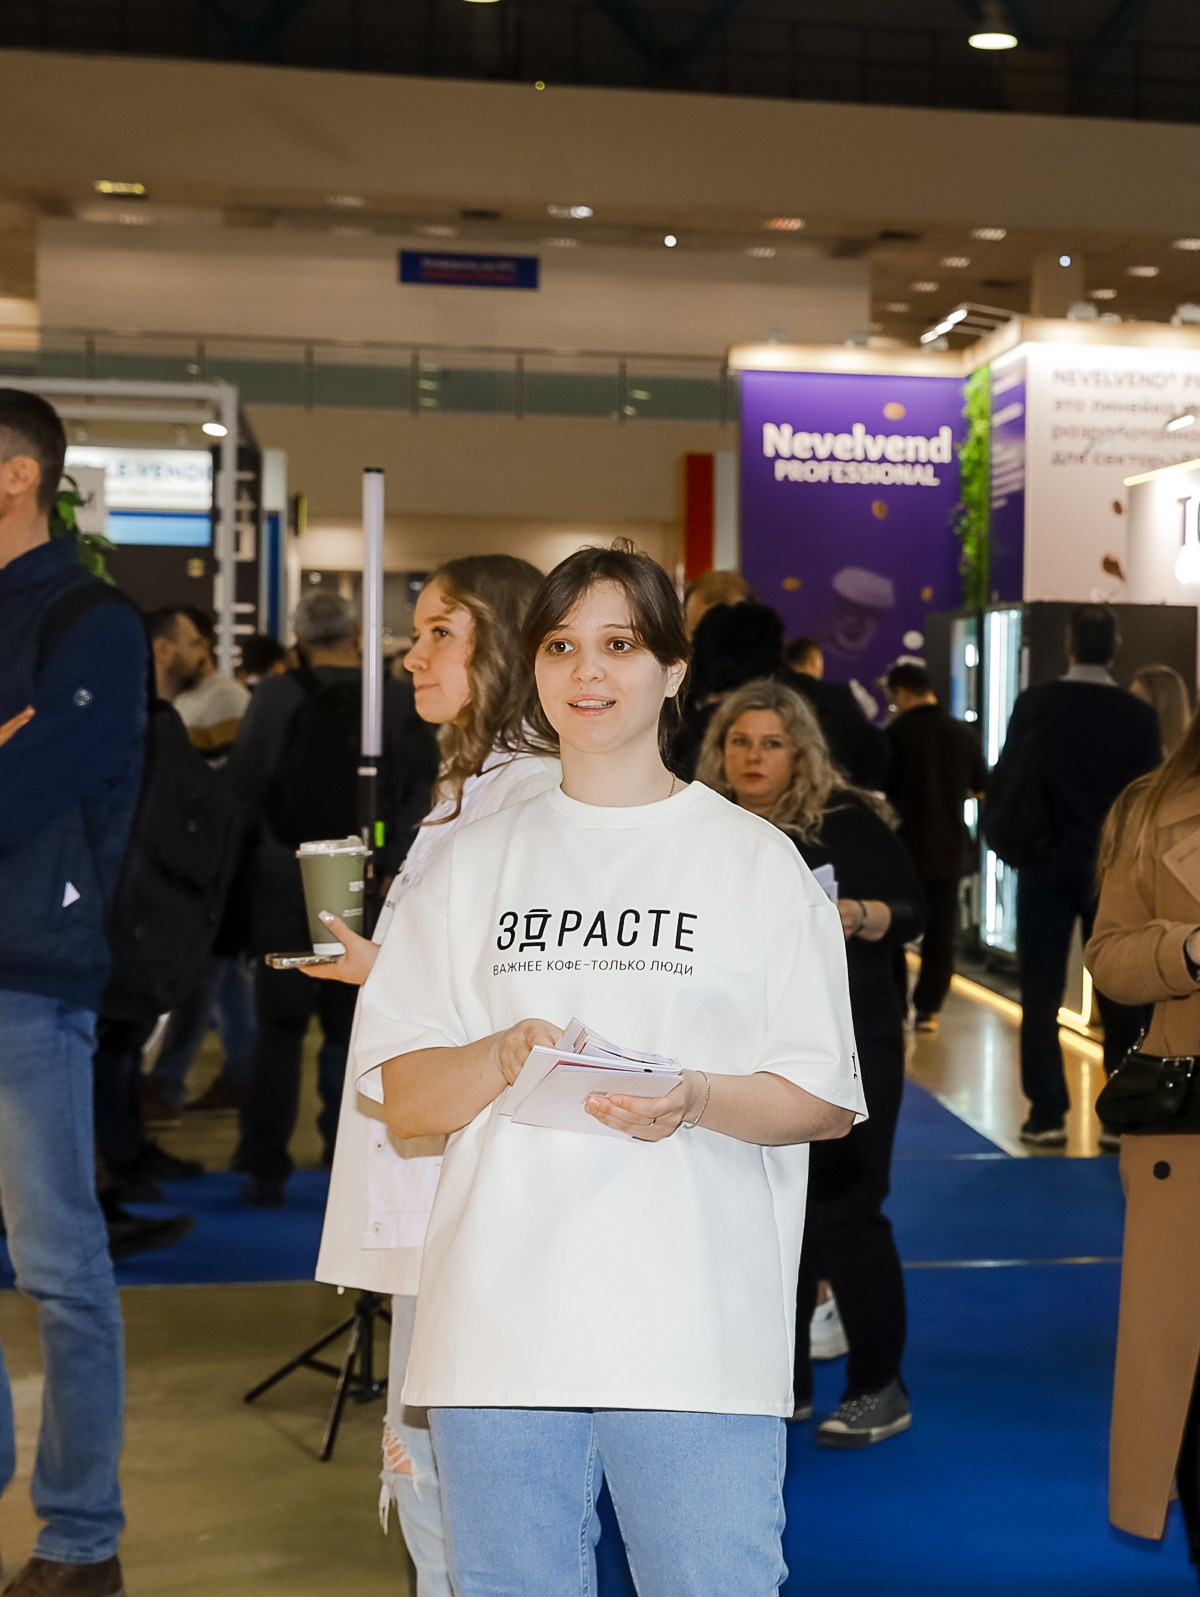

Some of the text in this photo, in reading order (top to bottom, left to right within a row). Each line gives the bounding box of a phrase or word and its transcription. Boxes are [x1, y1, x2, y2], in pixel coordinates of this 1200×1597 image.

[763, 422, 952, 464] Nevelvend
[774, 458, 941, 487] PROFESSIONAL
[496, 908, 698, 953] ЗДРАСТЕ
[493, 960, 543, 976] ВАЖНЕЕ
[649, 960, 694, 976] ЛЮДИ
